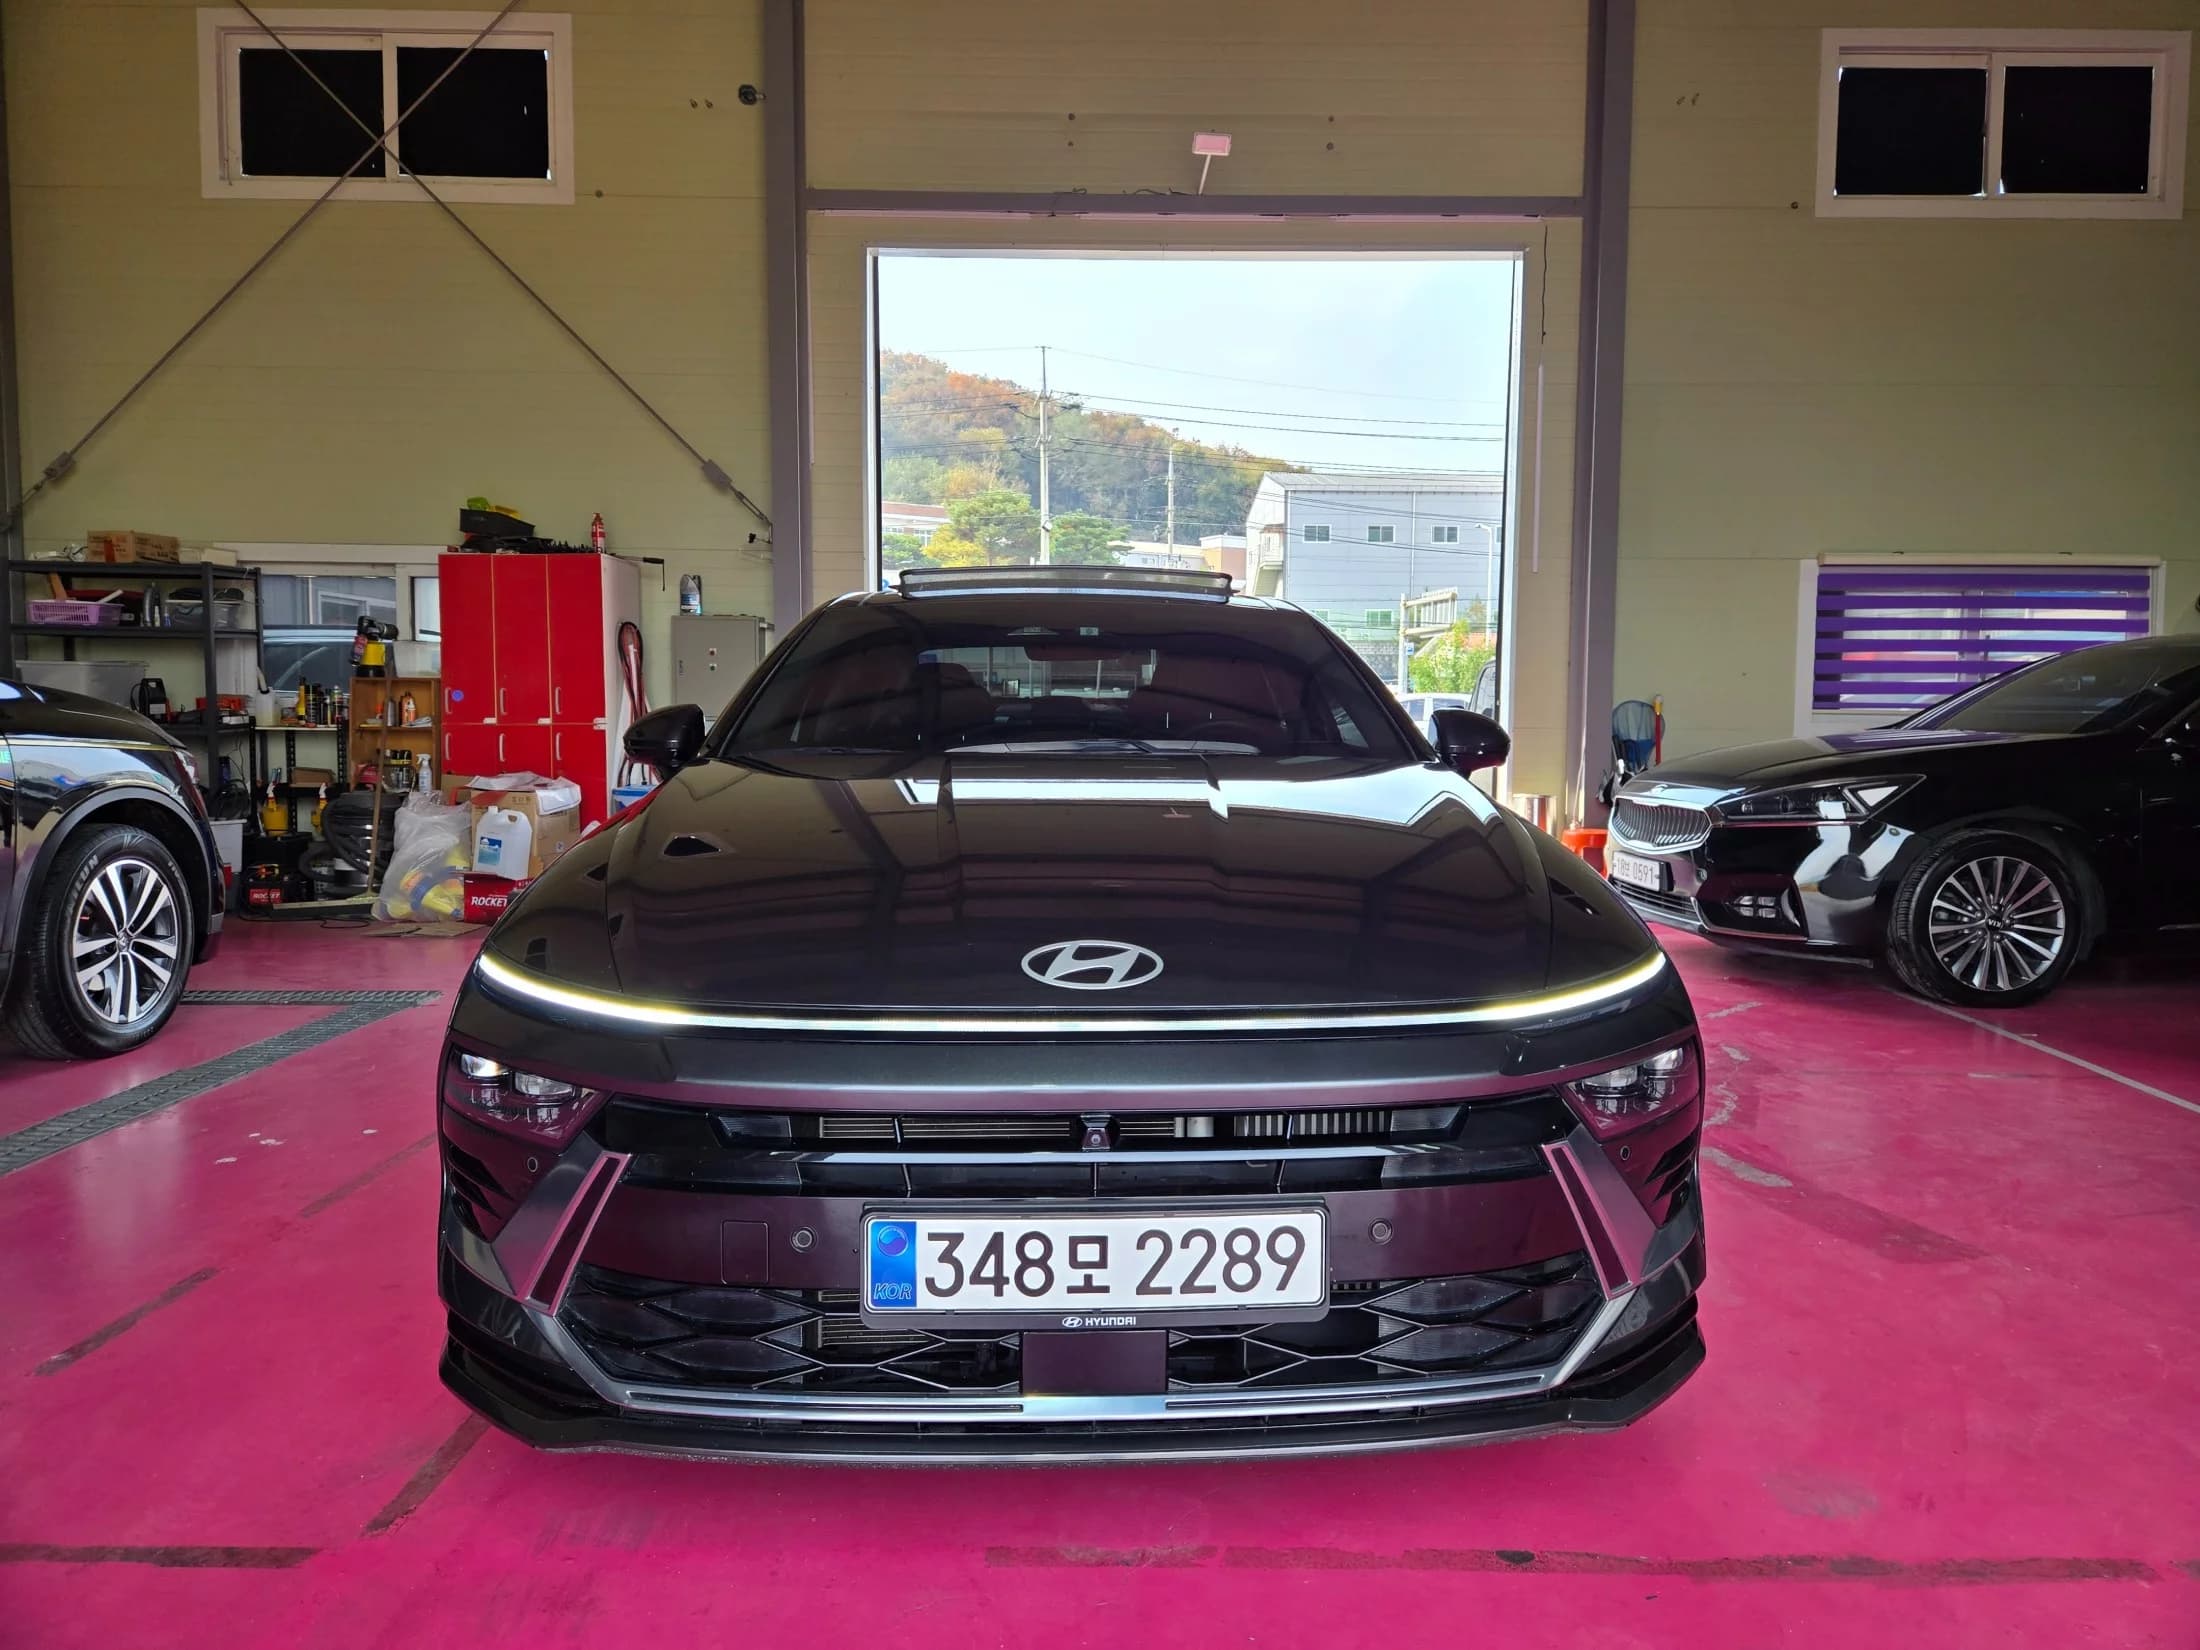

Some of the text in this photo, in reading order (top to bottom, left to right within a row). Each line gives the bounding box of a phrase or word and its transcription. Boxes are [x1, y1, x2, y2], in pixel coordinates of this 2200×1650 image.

[1633, 862, 1653, 884] 0591
[471, 896, 508, 907] ROCKET
[925, 1226, 1305, 1297] 348모 2289
[873, 1282, 912, 1299] KOR
[1085, 1316, 1136, 1326] HYUNDAI
